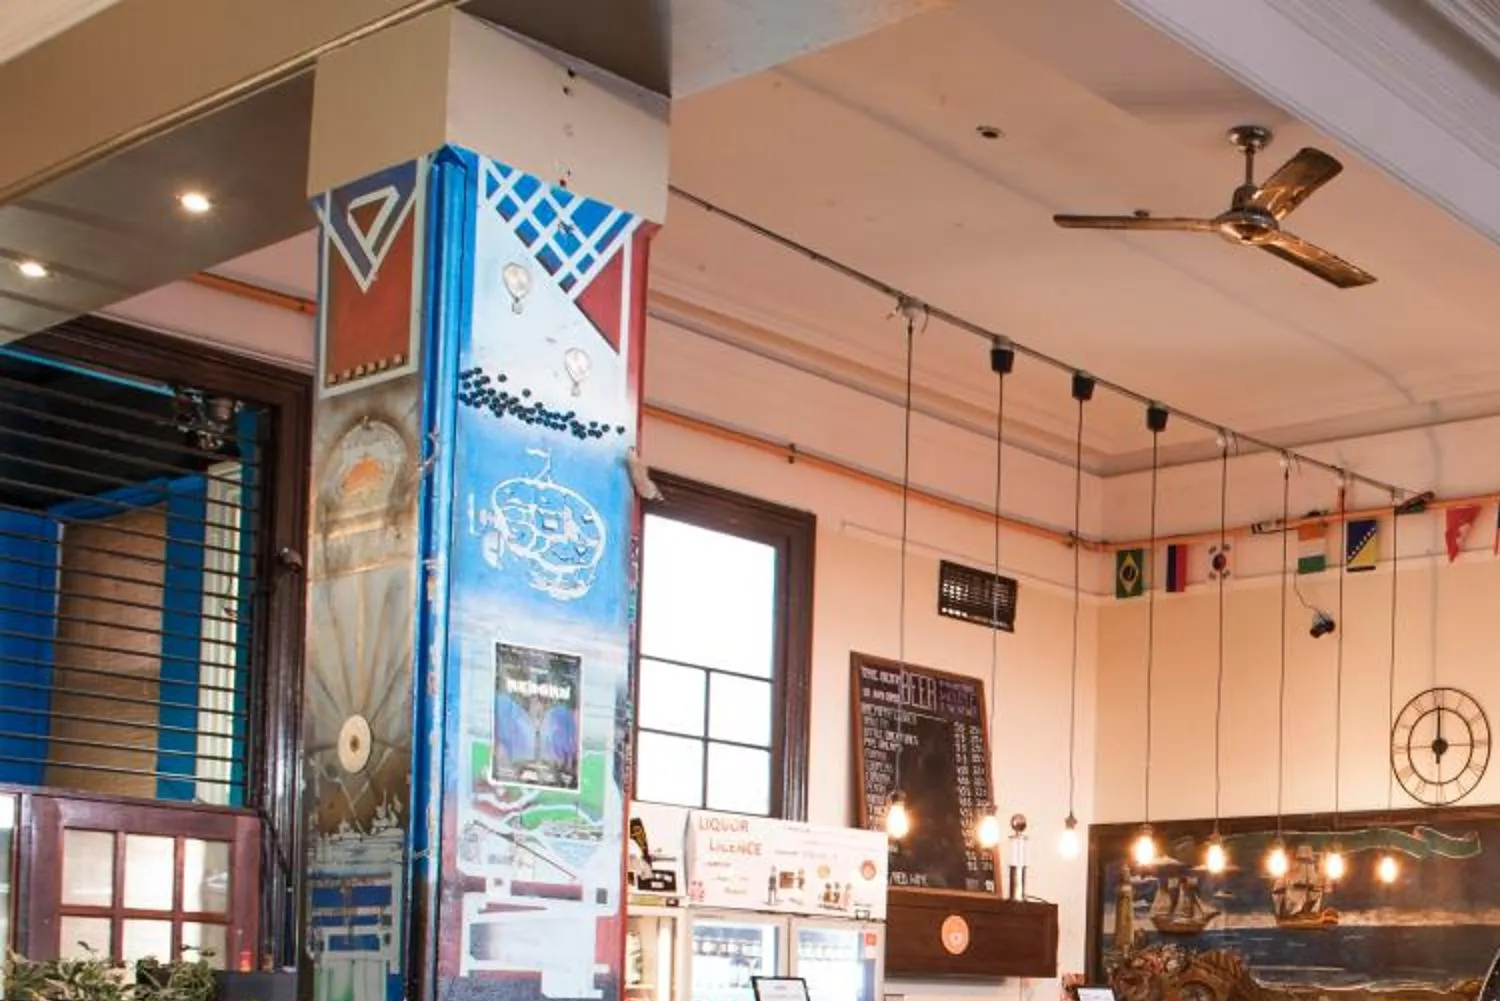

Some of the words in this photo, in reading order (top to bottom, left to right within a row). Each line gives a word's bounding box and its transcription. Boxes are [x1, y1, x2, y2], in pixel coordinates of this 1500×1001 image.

[506, 679, 571, 699] REBORN
[901, 671, 937, 712] BEER
[699, 815, 750, 833] LIQUOR
